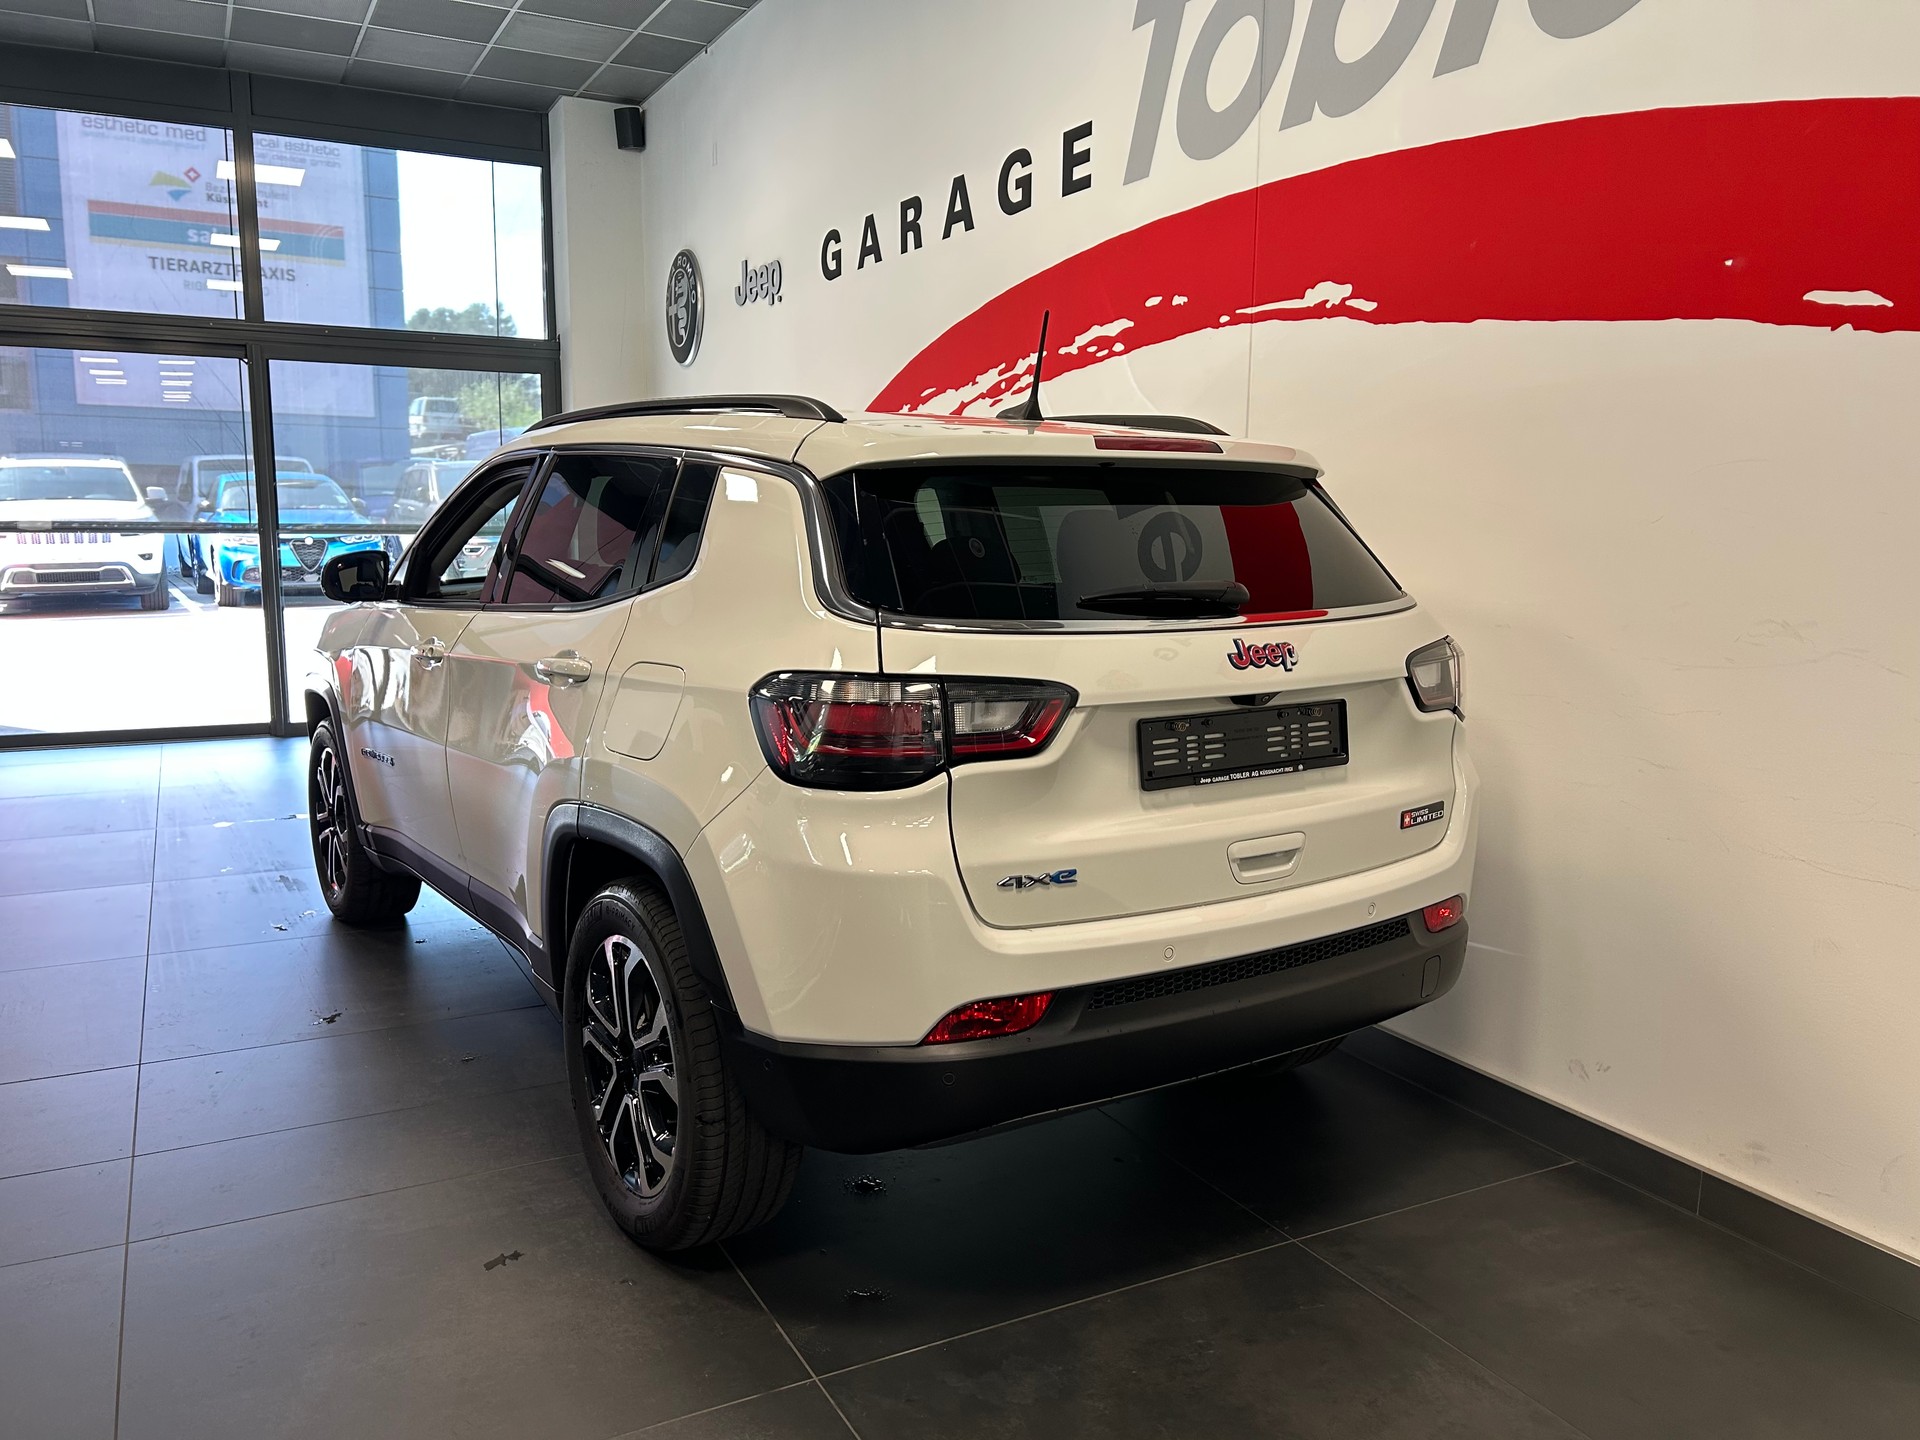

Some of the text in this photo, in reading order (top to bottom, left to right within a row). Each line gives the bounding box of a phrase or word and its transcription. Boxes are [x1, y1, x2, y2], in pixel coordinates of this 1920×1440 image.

[81, 115, 159, 136] esthetic
[165, 125, 207, 142] med
[284, 140, 341, 157] esthetic
[820, 119, 1093, 282] GARAGE
[1227, 637, 1299, 672] Jeep
[1229, 771, 1251, 780] TOBLER
[1410, 810, 1444, 825] LIMITED
[1411, 808, 1429, 818] SWISS
